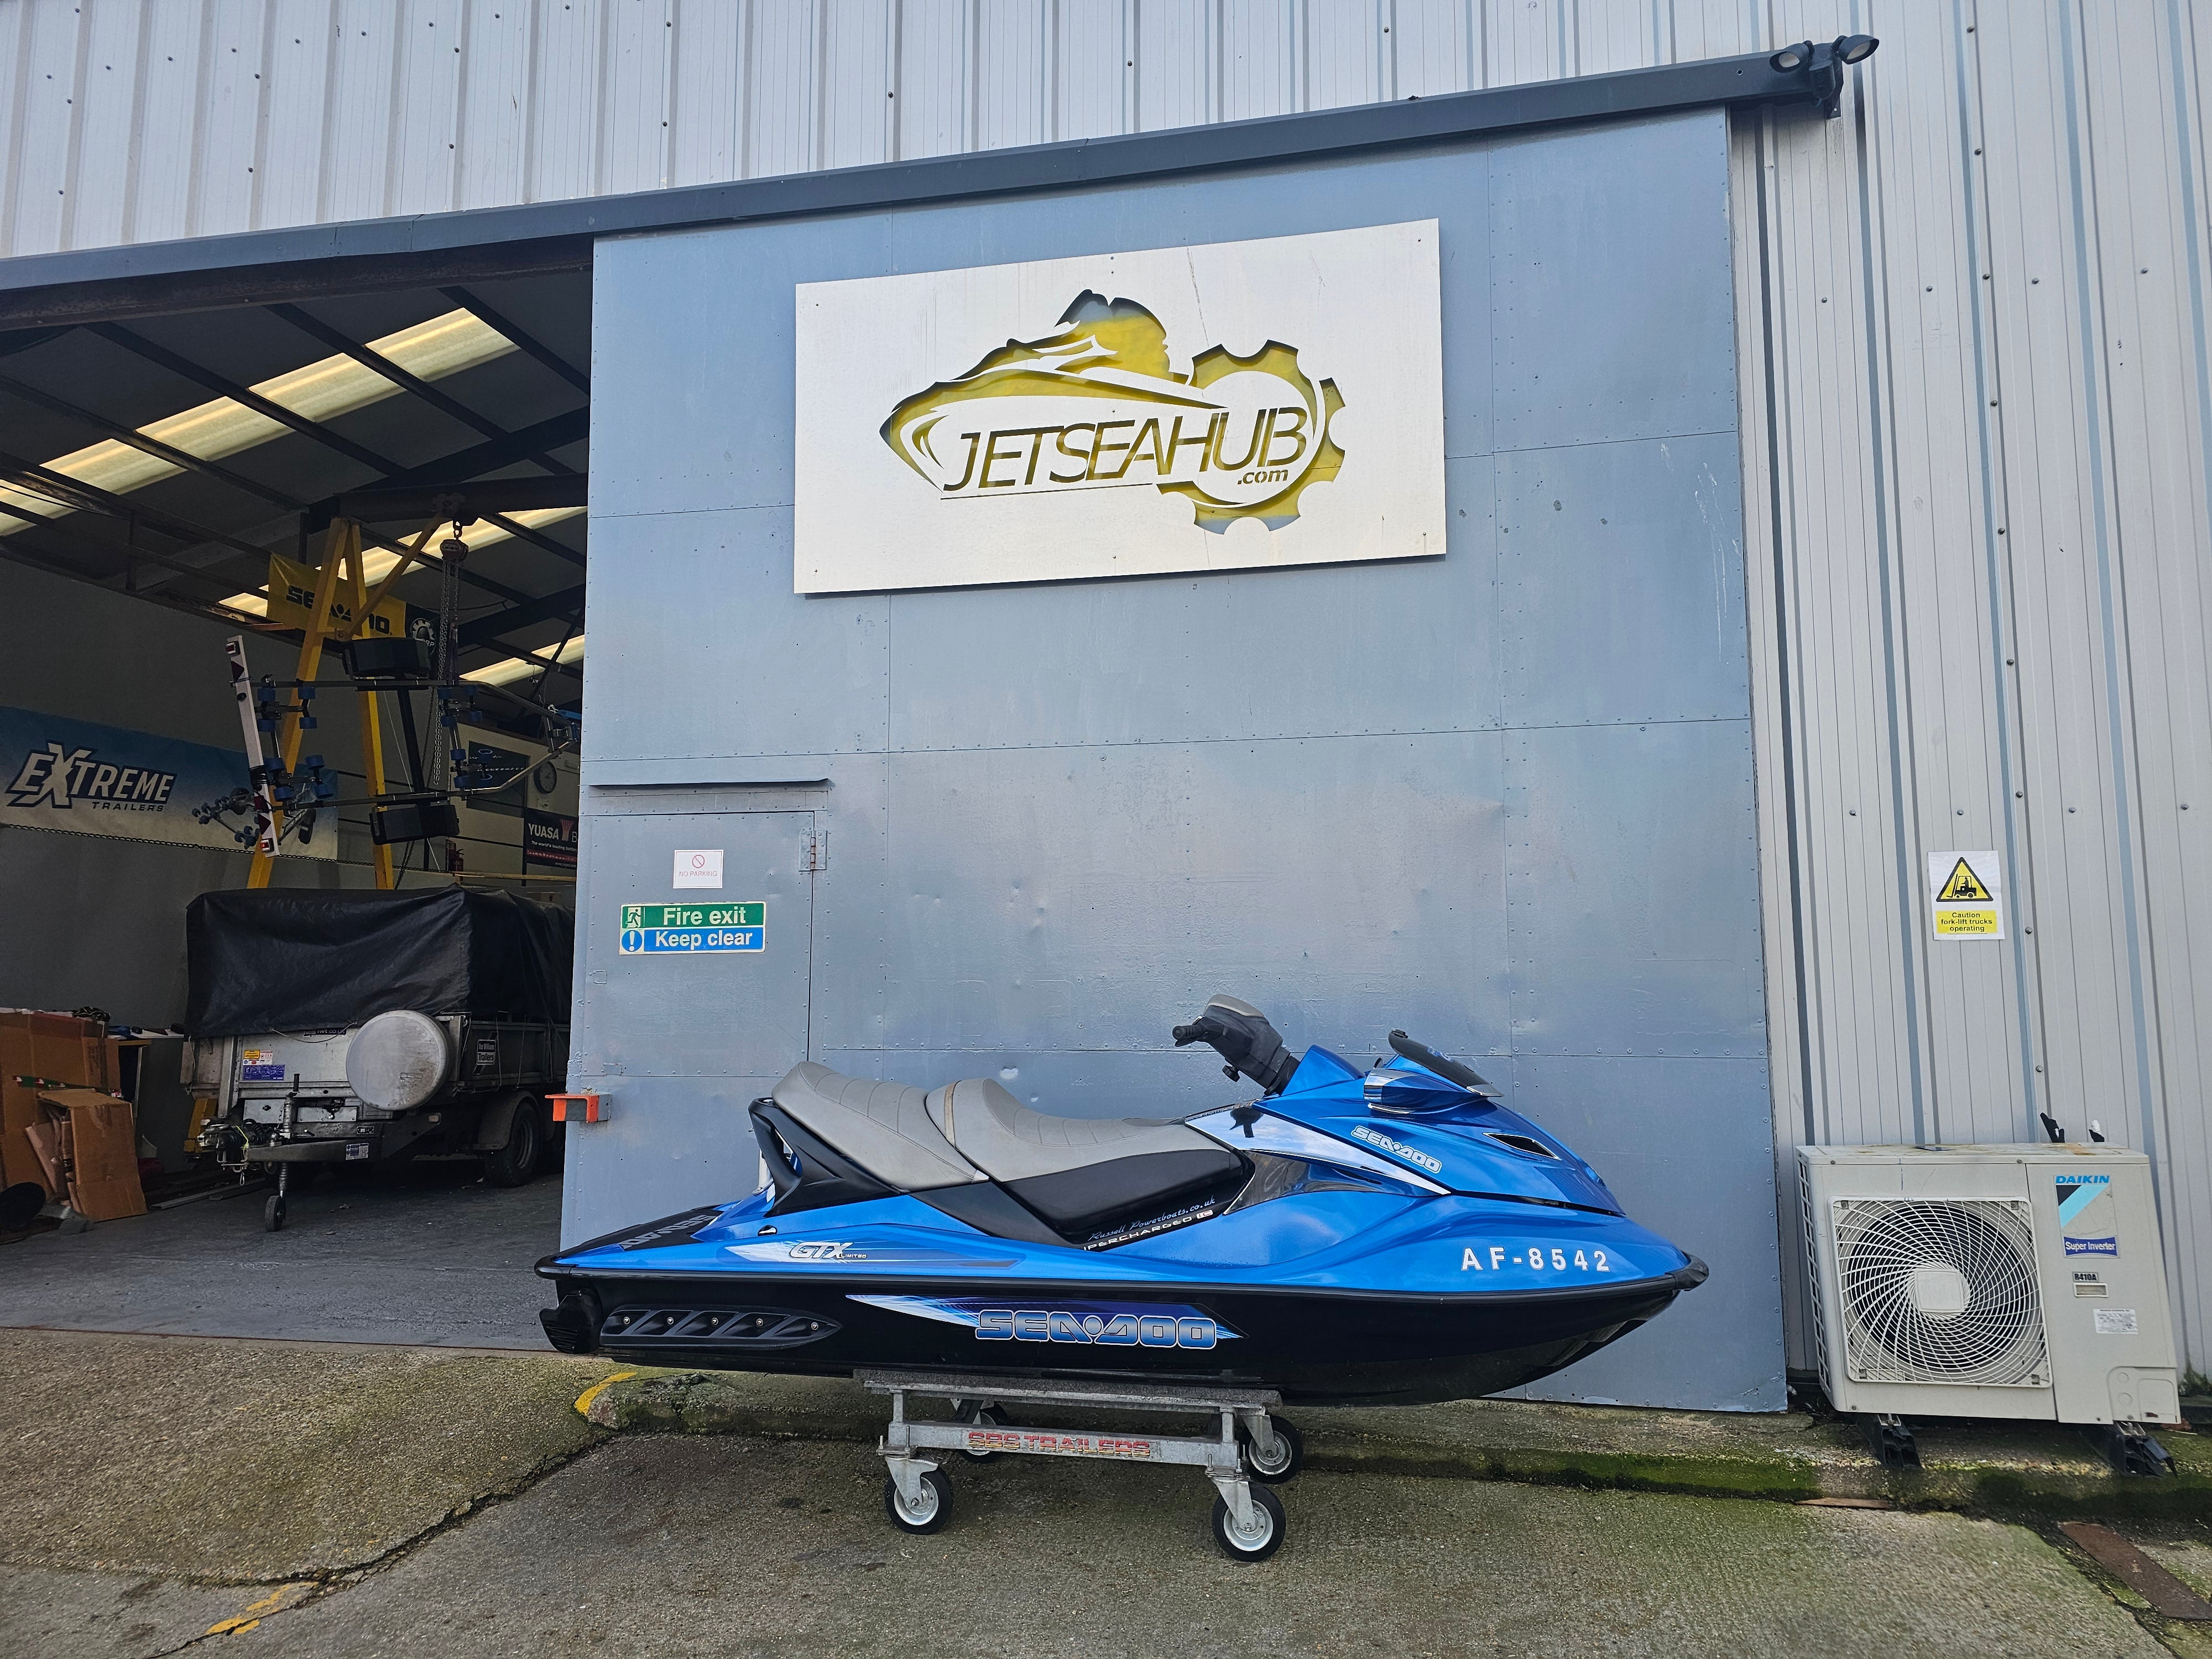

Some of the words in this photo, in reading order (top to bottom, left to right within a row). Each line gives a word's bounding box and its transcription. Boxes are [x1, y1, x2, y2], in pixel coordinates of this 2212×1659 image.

[943, 407, 1307, 492] JETSEAHUB
[1237, 468, 1288, 485] .com
[6, 740, 178, 808] EXTREME
[92, 801, 164, 812] TRAILERS
[528, 823, 559, 840] YUASA
[664, 907, 703, 925] Fire
[709, 906, 746, 924] exit
[655, 930, 702, 951] Keep
[707, 930, 753, 946] clear
[2055, 1175, 2110, 1184] DAIKIN
[1088, 1225, 1126, 1242] Russell
[1129, 1194, 1215, 1230] Powerboats.co.uk
[790, 1241, 854, 1259] GTX
[2065, 1241, 2086, 1252] Super
[2088, 1241, 2115, 1250] Inverter
[1461, 1247, 1610, 1272] AF-8542
[968, 1432, 1020, 1450] SBS
[1024, 1434, 1151, 1458] TRAILERS
